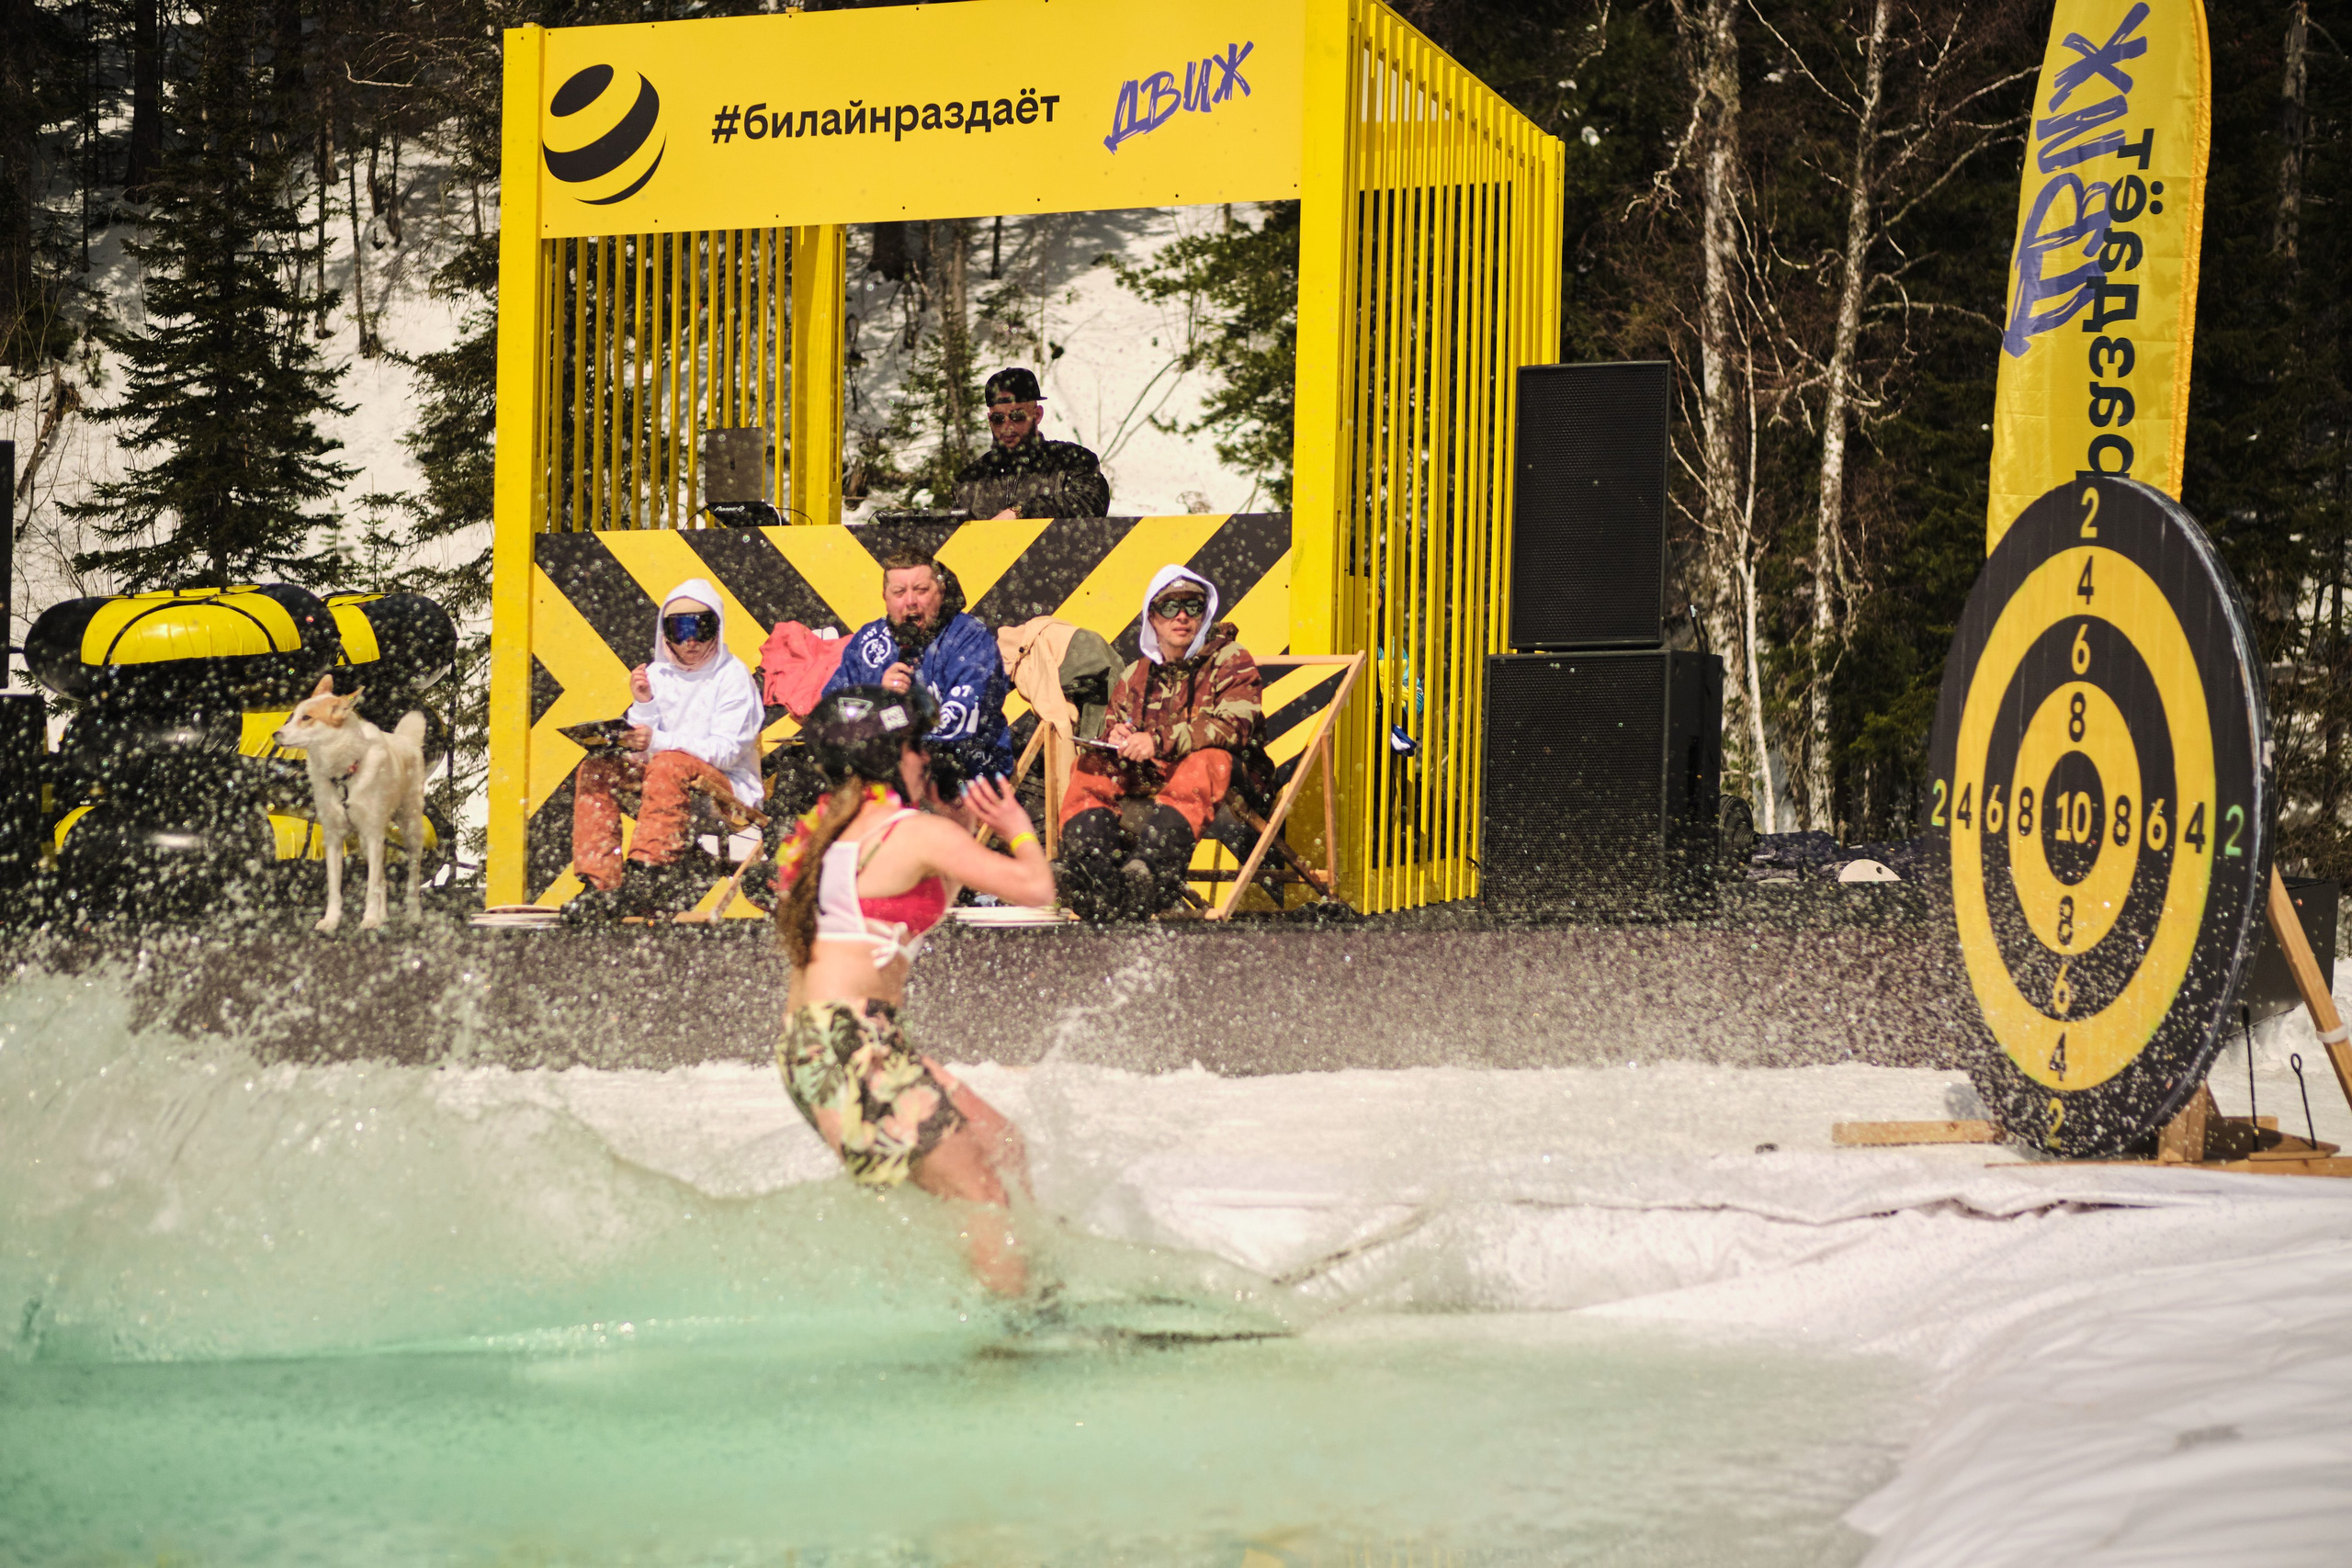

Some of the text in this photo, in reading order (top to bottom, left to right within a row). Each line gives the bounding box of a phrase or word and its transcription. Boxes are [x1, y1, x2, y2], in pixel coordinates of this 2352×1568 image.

[712, 87, 1060, 144] #билайнраздаёт
[1102, 40, 1254, 155] ДВИЖ
[2080, 486, 2099, 538] 2
[2076, 555, 2095, 605] 4
[2071, 623, 2091, 675] 6
[2068, 691, 2086, 743] 8
[1930, 778, 2245, 857] 2 4 6 8 10 8 6 4 2
[2057, 895, 2075, 946] 8
[2052, 963, 2071, 1016] 6
[2049, 1032, 2066, 1082] 4
[2046, 1097, 2065, 1148] 2
